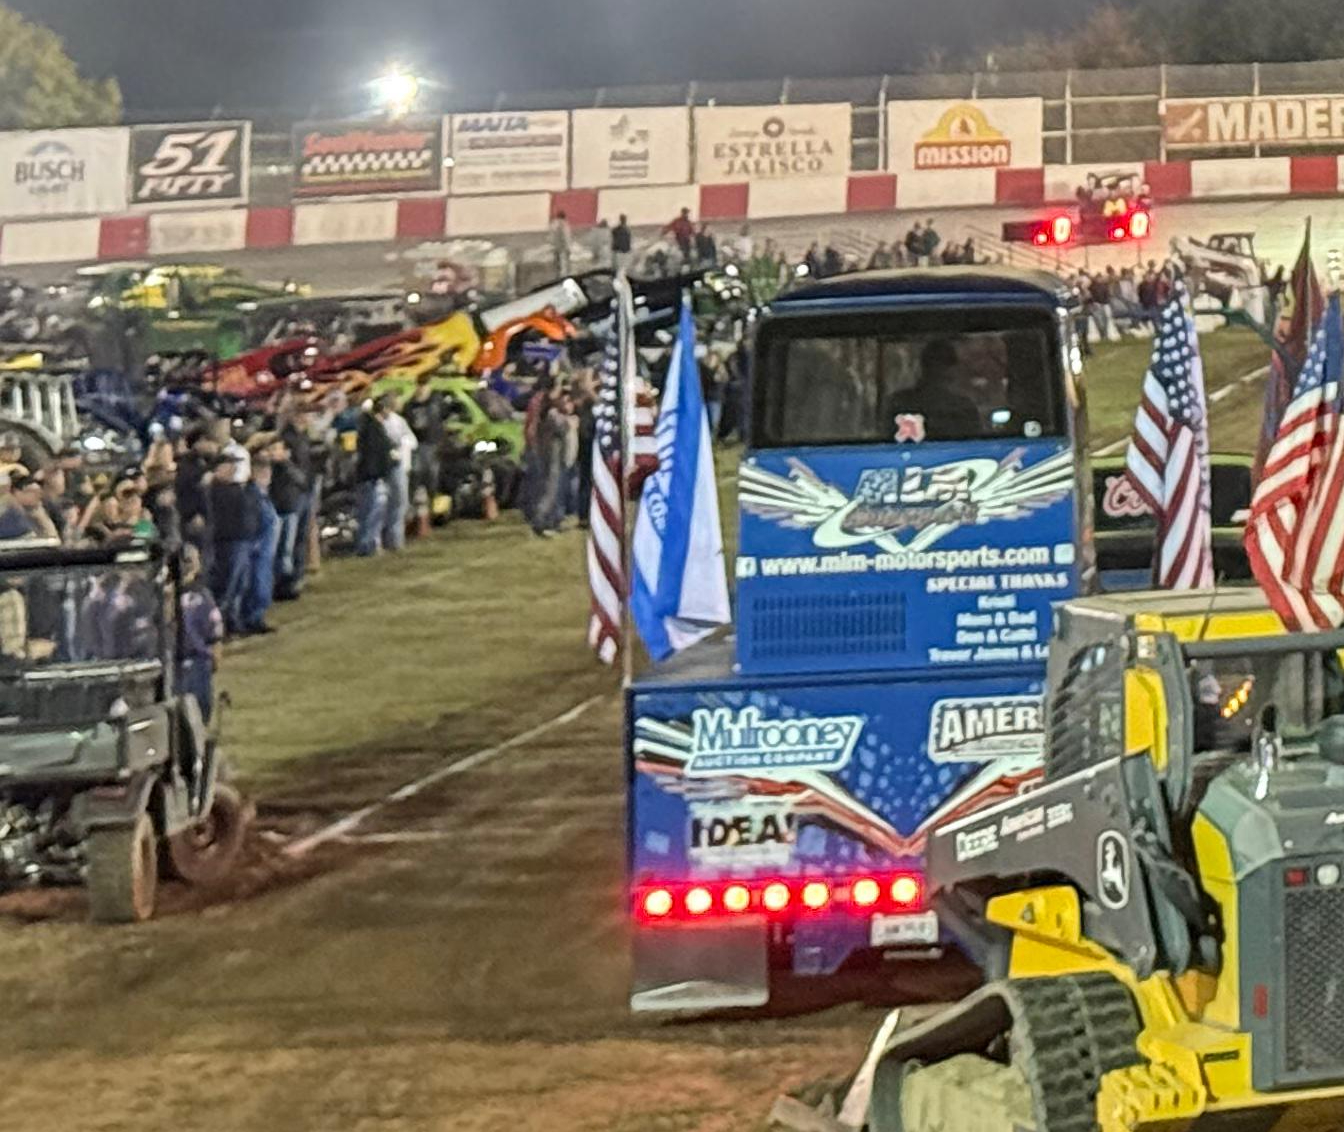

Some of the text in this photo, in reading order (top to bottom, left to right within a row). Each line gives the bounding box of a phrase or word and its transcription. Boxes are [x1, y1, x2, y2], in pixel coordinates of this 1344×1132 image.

[140, 130, 238, 174] 51
[713, 139, 834, 160] ESTRELLA
[15, 159, 86, 184] BUSCH
[724, 157, 823, 176] JALISCO
[137, 173, 235, 198] FIFTY
[761, 544, 1049, 576] www.mlm-motorsports.com
[698, 711, 856, 750] Mulrooney
